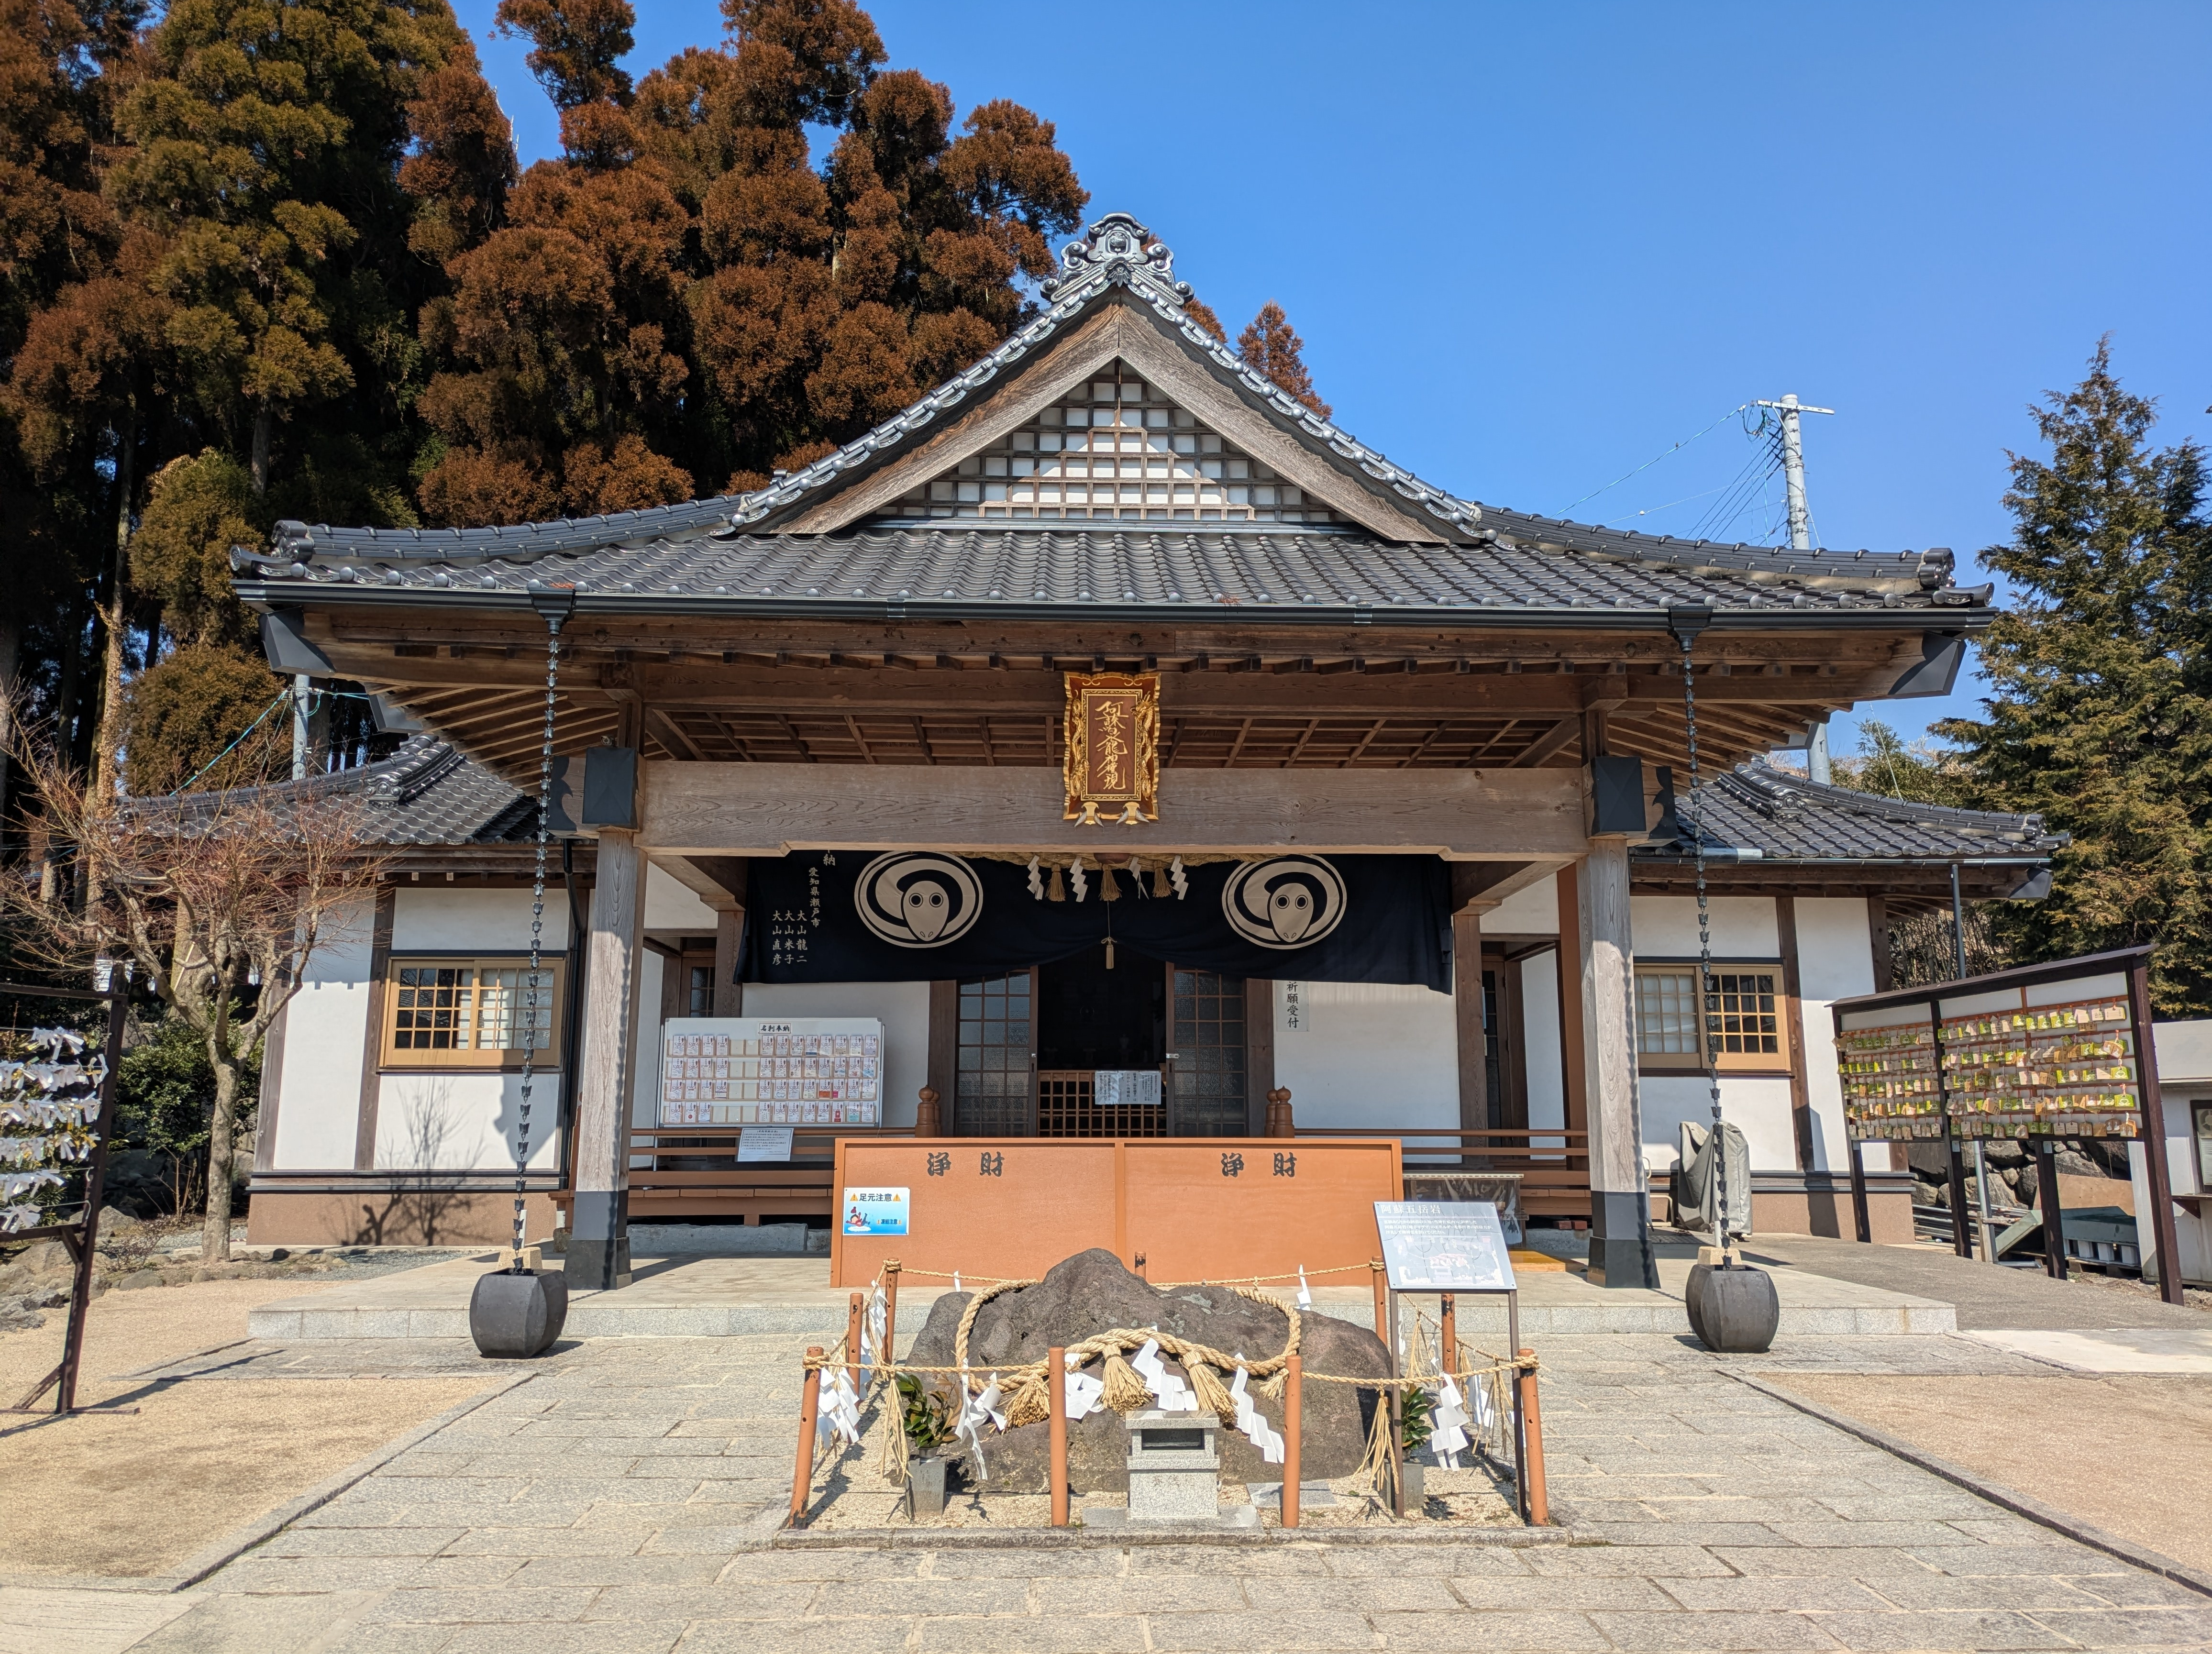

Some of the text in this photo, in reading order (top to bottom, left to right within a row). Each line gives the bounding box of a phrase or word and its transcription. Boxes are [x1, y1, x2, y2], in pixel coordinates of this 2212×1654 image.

[823, 849, 835, 866] 納
[808, 867, 821, 928] 愛知県瀬戸市
[772, 910, 783, 966] 大山直彦
[784, 910, 796, 964] 大山米子
[796, 910, 808, 963] 大山龍二
[1286, 981, 1299, 1028] 祈願受付
[859, 1193, 892, 1202] 足元注意
[1381, 1204, 1441, 1214] 阿蘇五岳岩
